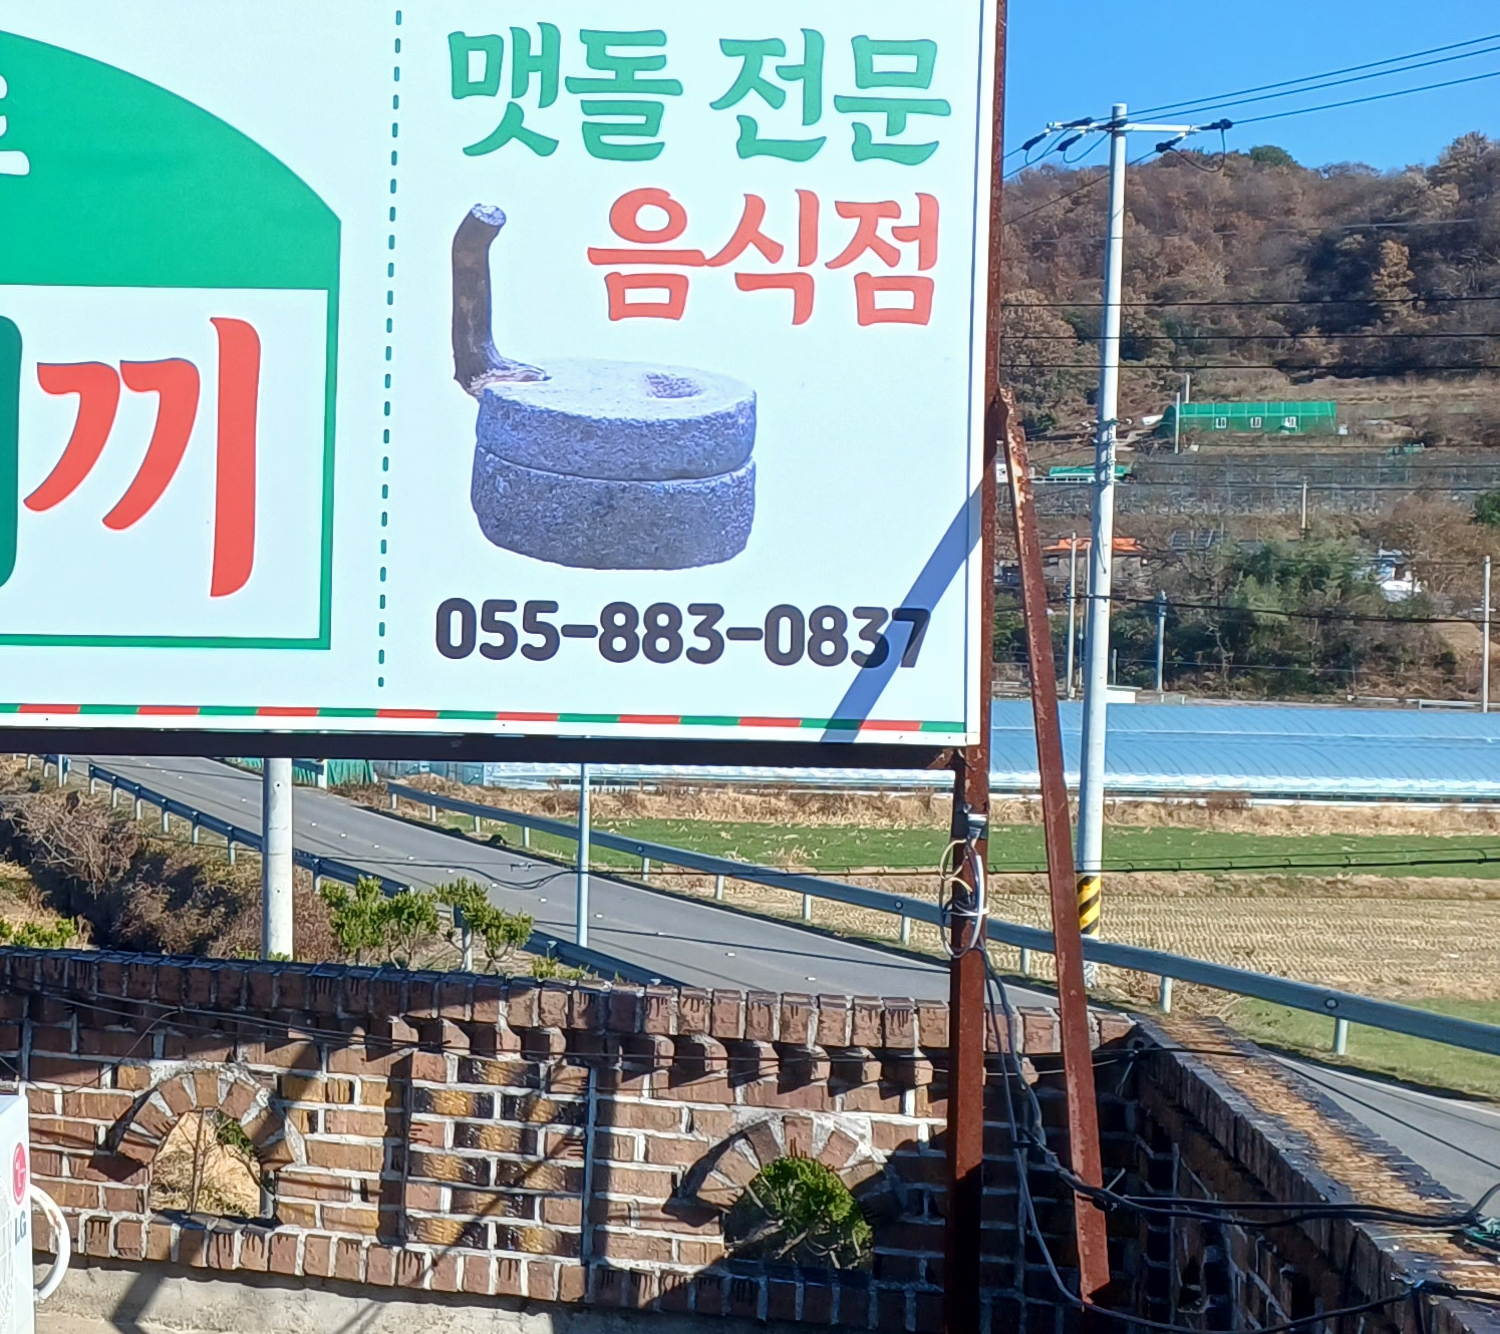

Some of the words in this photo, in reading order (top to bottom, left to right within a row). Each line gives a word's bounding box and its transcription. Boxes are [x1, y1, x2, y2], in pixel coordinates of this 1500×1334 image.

[448, 22, 683, 162] 맷돌
[710, 29, 951, 166] 전문
[588, 188, 938, 326] 음식점
[436, 598, 930, 668] 055-883-0837
[14, 1209, 27, 1246] LG
